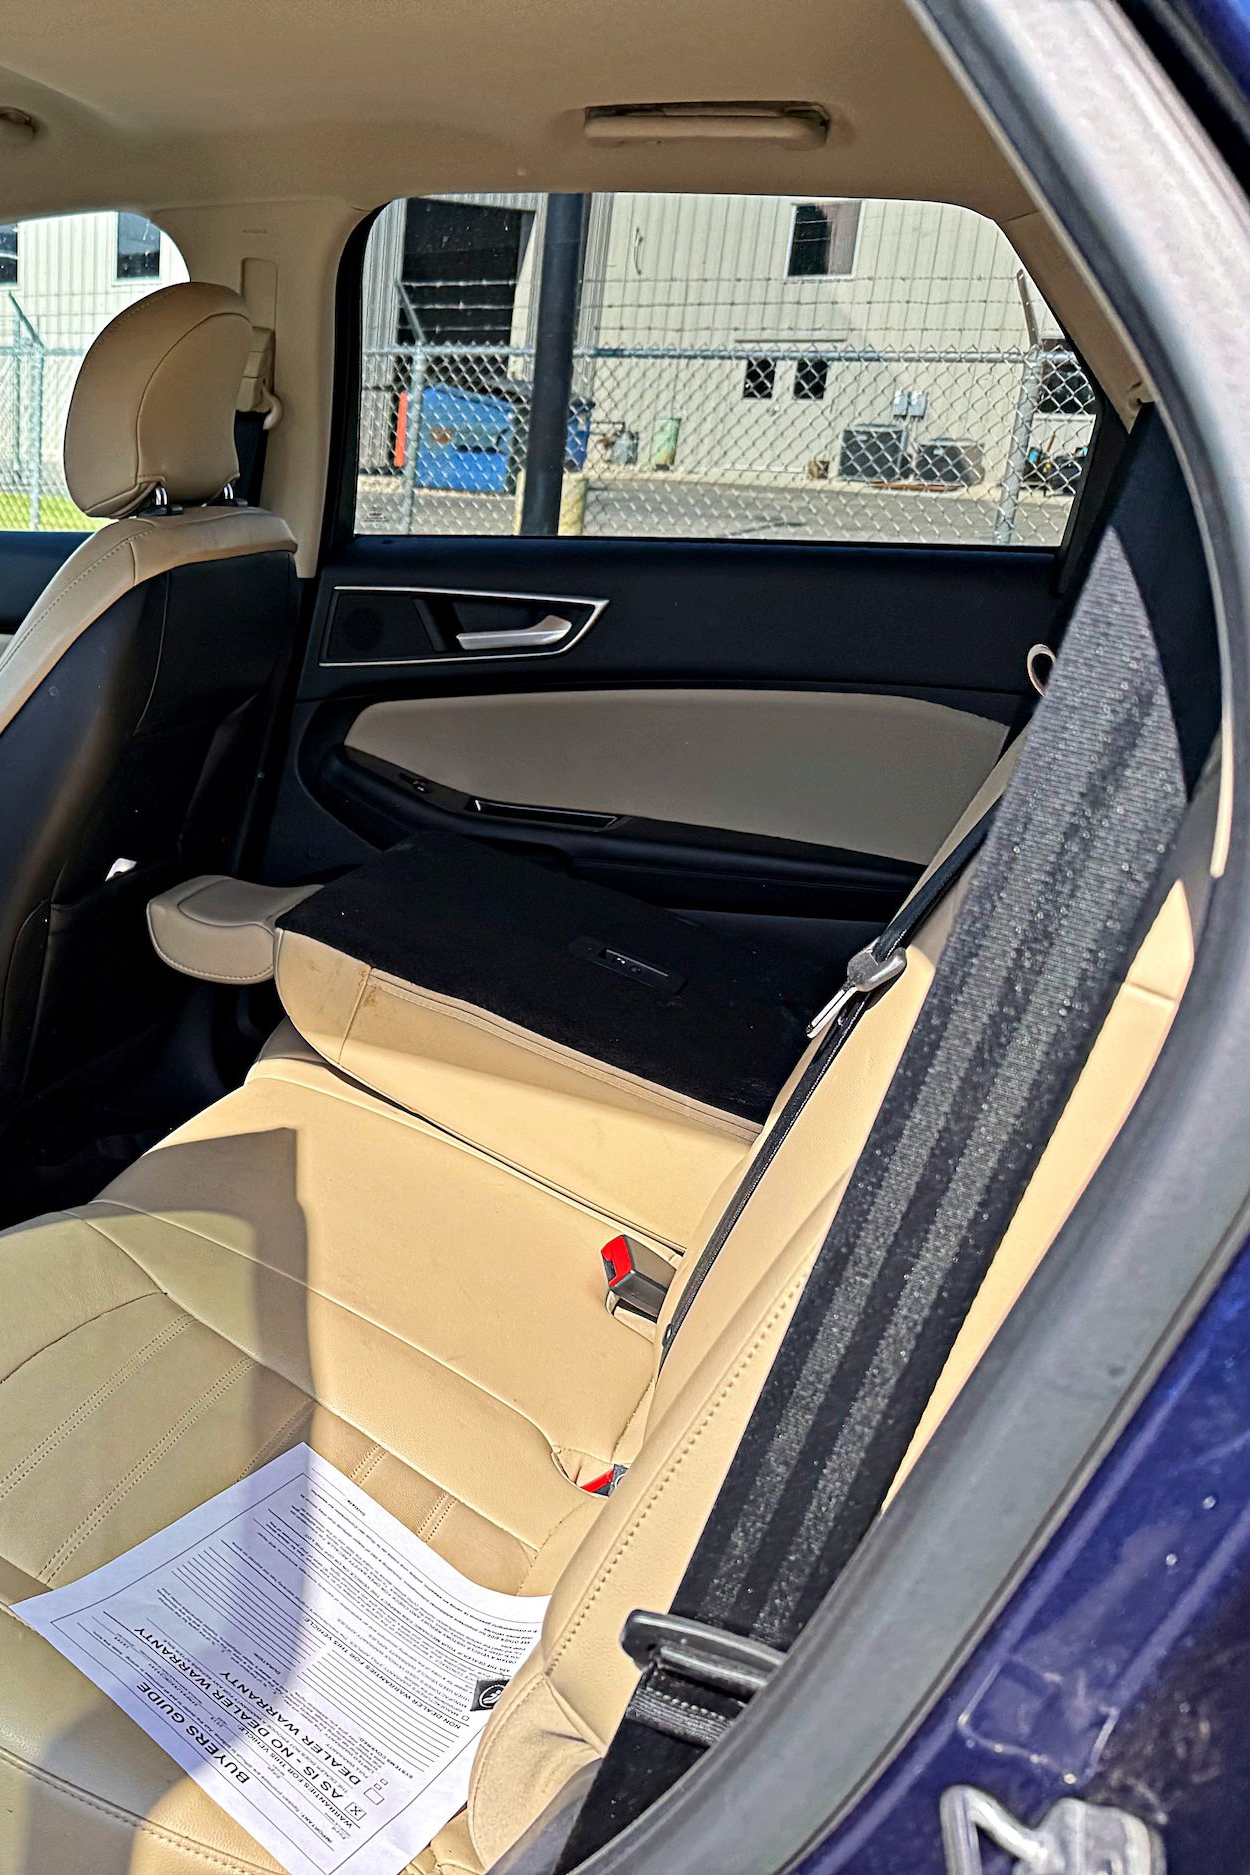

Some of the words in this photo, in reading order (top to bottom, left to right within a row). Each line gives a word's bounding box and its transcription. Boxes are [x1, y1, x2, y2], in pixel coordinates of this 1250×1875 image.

[134, 1625, 212, 1690] WARRANTY
[332, 1639, 348, 1653] THIS
[348, 1652, 364, 1665] FOR
[364, 1664, 411, 1699] WARRANTIES
[135, 1681, 186, 1725] GUIDE
[210, 1689, 270, 1737] DEALER
[218, 1669, 301, 1735] WARRANTY
[411, 1698, 461, 1729] NON-DEALER
[184, 1724, 250, 1784] BUYERS
[269, 1736, 294, 1758] NO
[269, 1752, 286, 1767] THIS
[300, 1734, 361, 1785] DEALER
[286, 1767, 303, 1782] FOR
[301, 1764, 319, 1780] IS
[302, 1782, 352, 1828] WARRANTIES
[318, 1779, 343, 1801] AS
